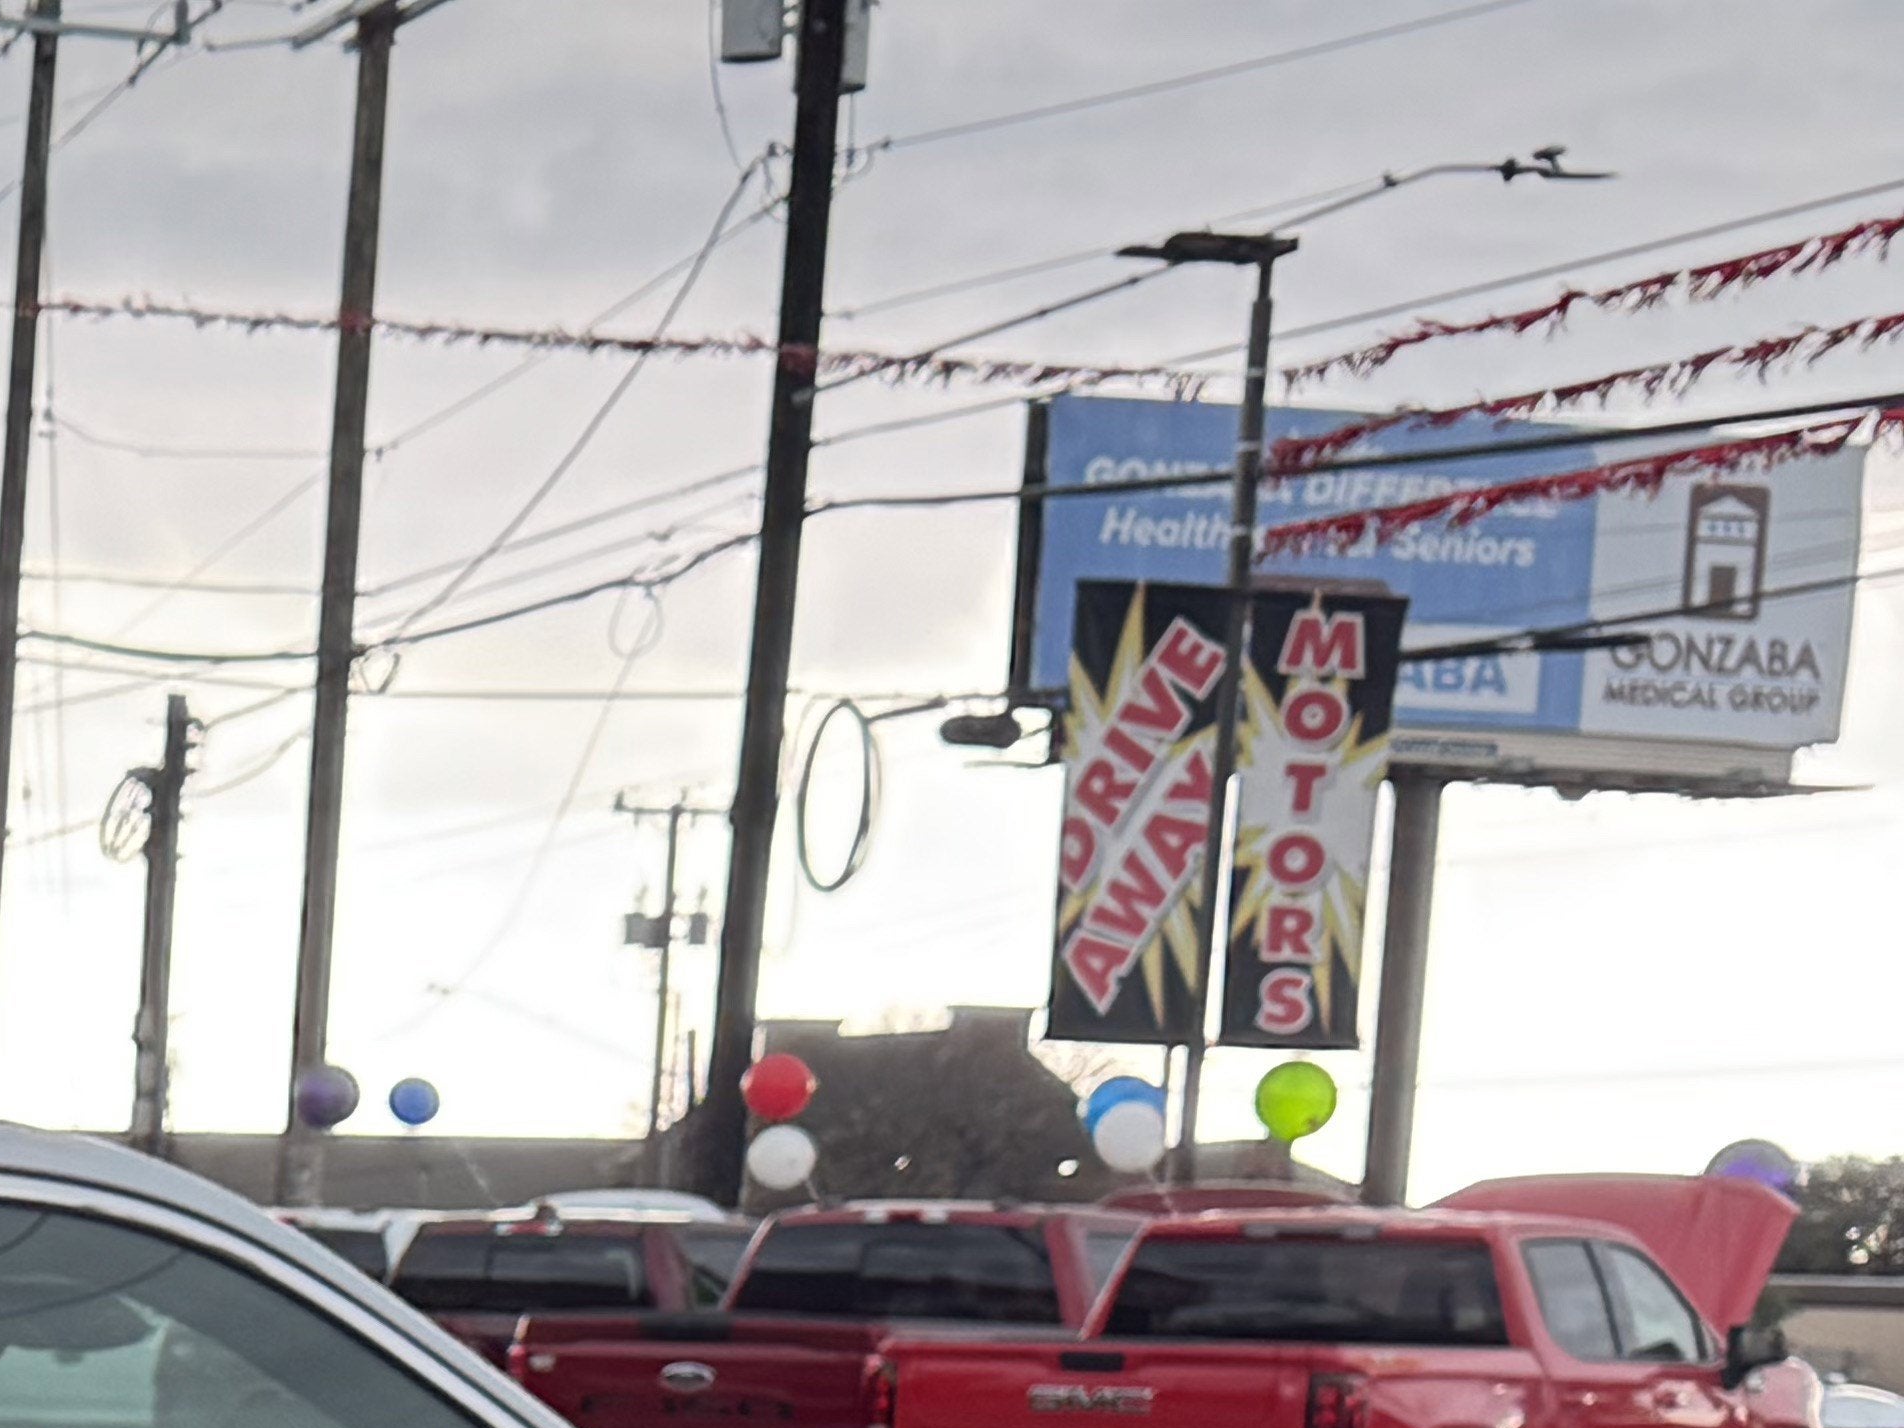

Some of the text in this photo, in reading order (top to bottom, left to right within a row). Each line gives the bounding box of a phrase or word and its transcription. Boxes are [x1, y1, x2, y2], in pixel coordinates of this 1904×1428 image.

[1391, 522, 1536, 567] Seniors
[1061, 622, 1226, 889] DRIVE
[1065, 749, 1213, 1005] AWAY
[1262, 614, 1361, 1032] MOTORS
